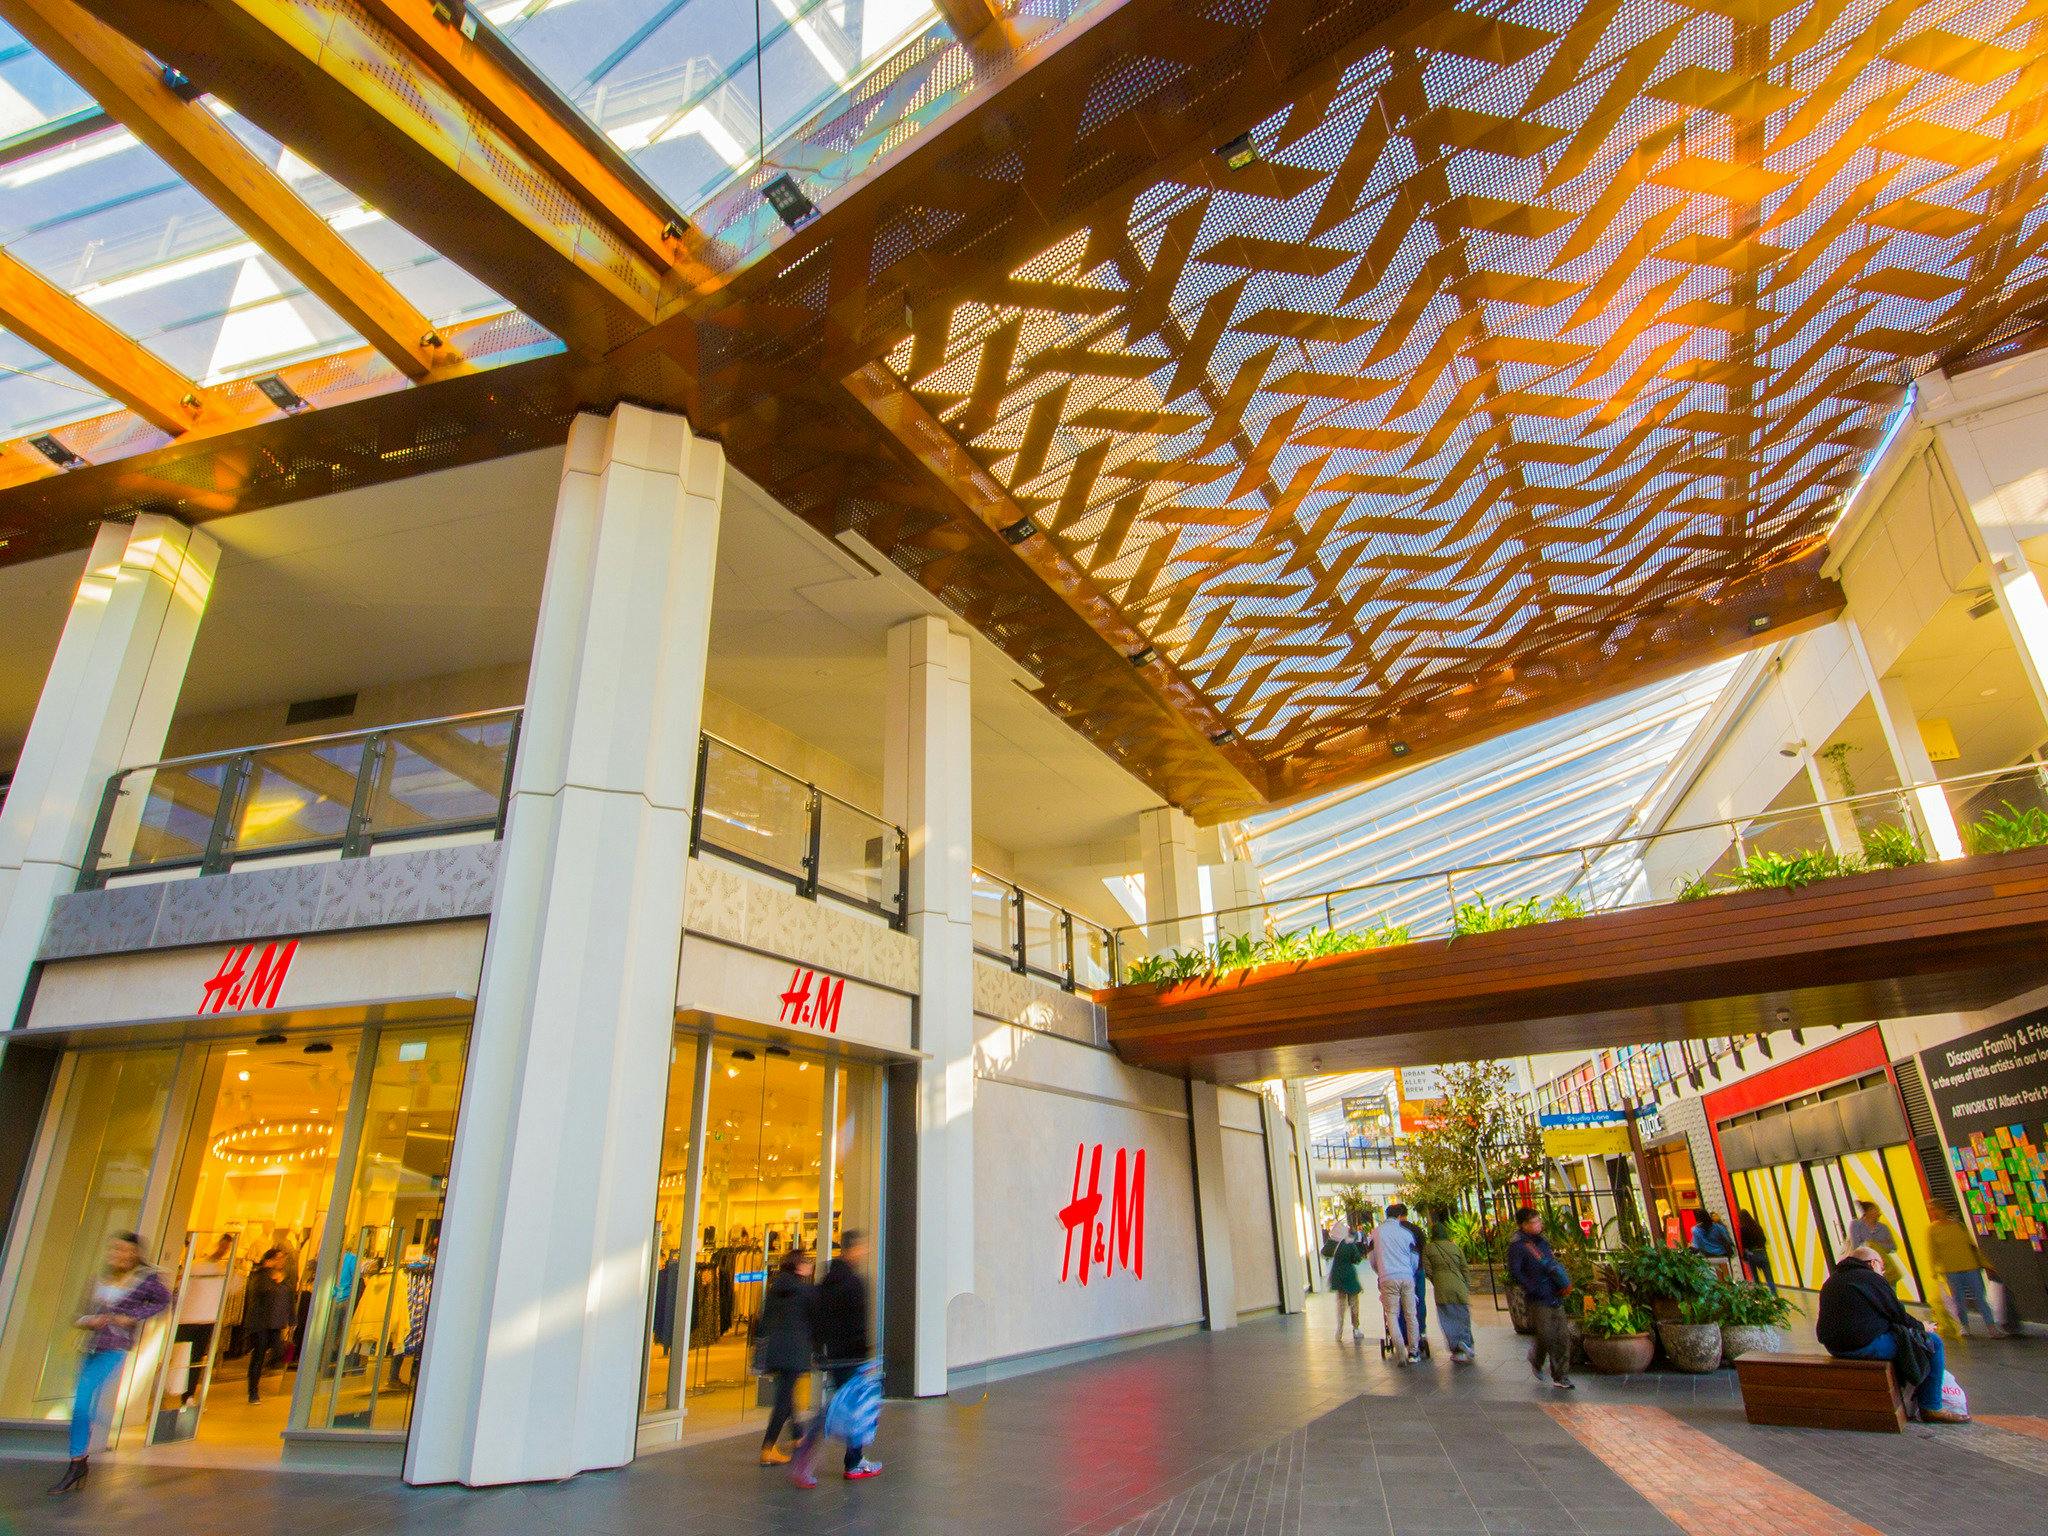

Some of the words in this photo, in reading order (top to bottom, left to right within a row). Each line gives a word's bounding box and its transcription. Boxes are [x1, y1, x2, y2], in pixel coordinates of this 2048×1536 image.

[198, 941, 298, 1015] H&M
[781, 968, 845, 1033] H&M
[1932, 1079, 1939, 1090] in
[1939, 1076, 1950, 1088] the
[1950, 1074, 1965, 1087] eyes
[1965, 1068, 1973, 1081] of
[1972, 1064, 1990, 1079] little
[1990, 1059, 2015, 1075] artists
[2014, 1055, 2023, 1068] in
[2023, 1053, 2037, 1066] our
[1946, 1046, 1984, 1067] Discover
[1983, 1034, 2017, 1056] Family
[2016, 1029, 2028, 1046] &
[1951, 1099, 1988, 1118] ARTWORK
[1987, 1097, 1998, 1110] BY
[1999, 1094, 2023, 1108] Albert
[2021, 1088, 2042, 1103] Park
[1058, 1144, 1146, 1286] H&M
